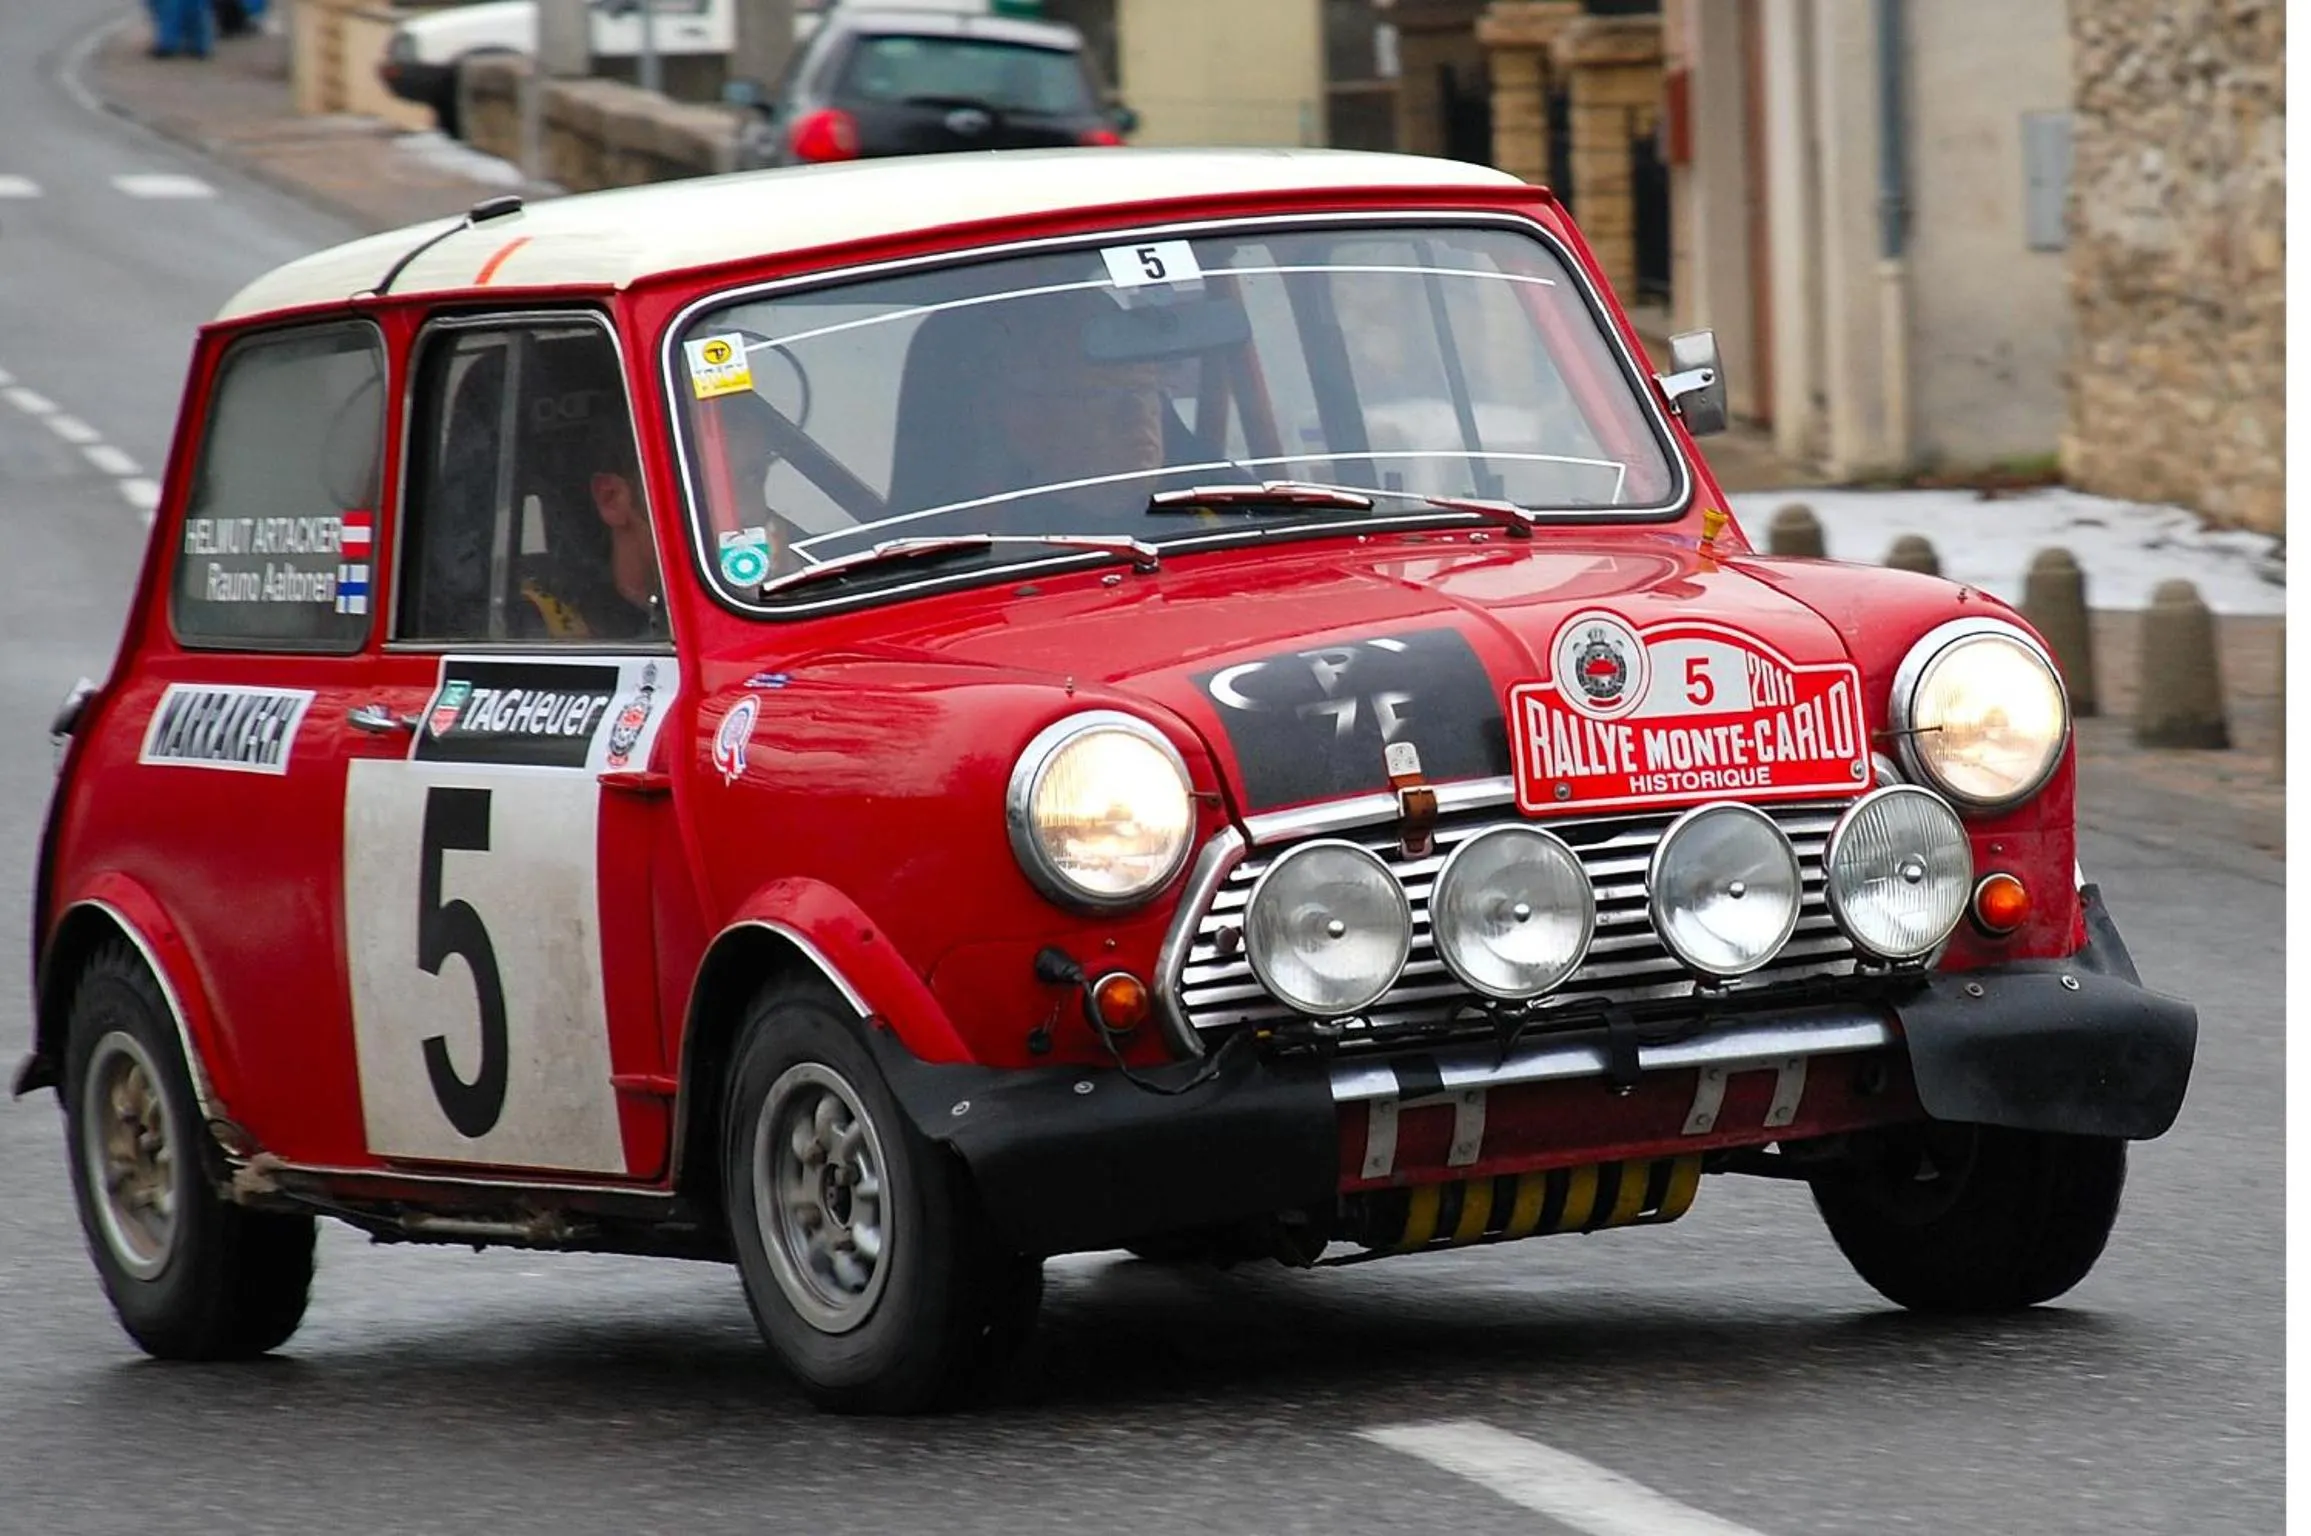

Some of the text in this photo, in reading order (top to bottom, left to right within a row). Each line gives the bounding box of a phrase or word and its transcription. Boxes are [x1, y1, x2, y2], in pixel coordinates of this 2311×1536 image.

[1136, 247, 1166, 279] 5
[184, 516, 342, 554] HELMUT ARTACKER
[206, 562, 261, 602] Rauno
[1685, 656, 1714, 706] 5
[1746, 650, 1797, 708] 2011
[1524, 679, 1856, 780] RALLYE MONTE-CARLO
[1628, 766, 1772, 794] HISTORIQUE
[419, 786, 509, 1139] 5
